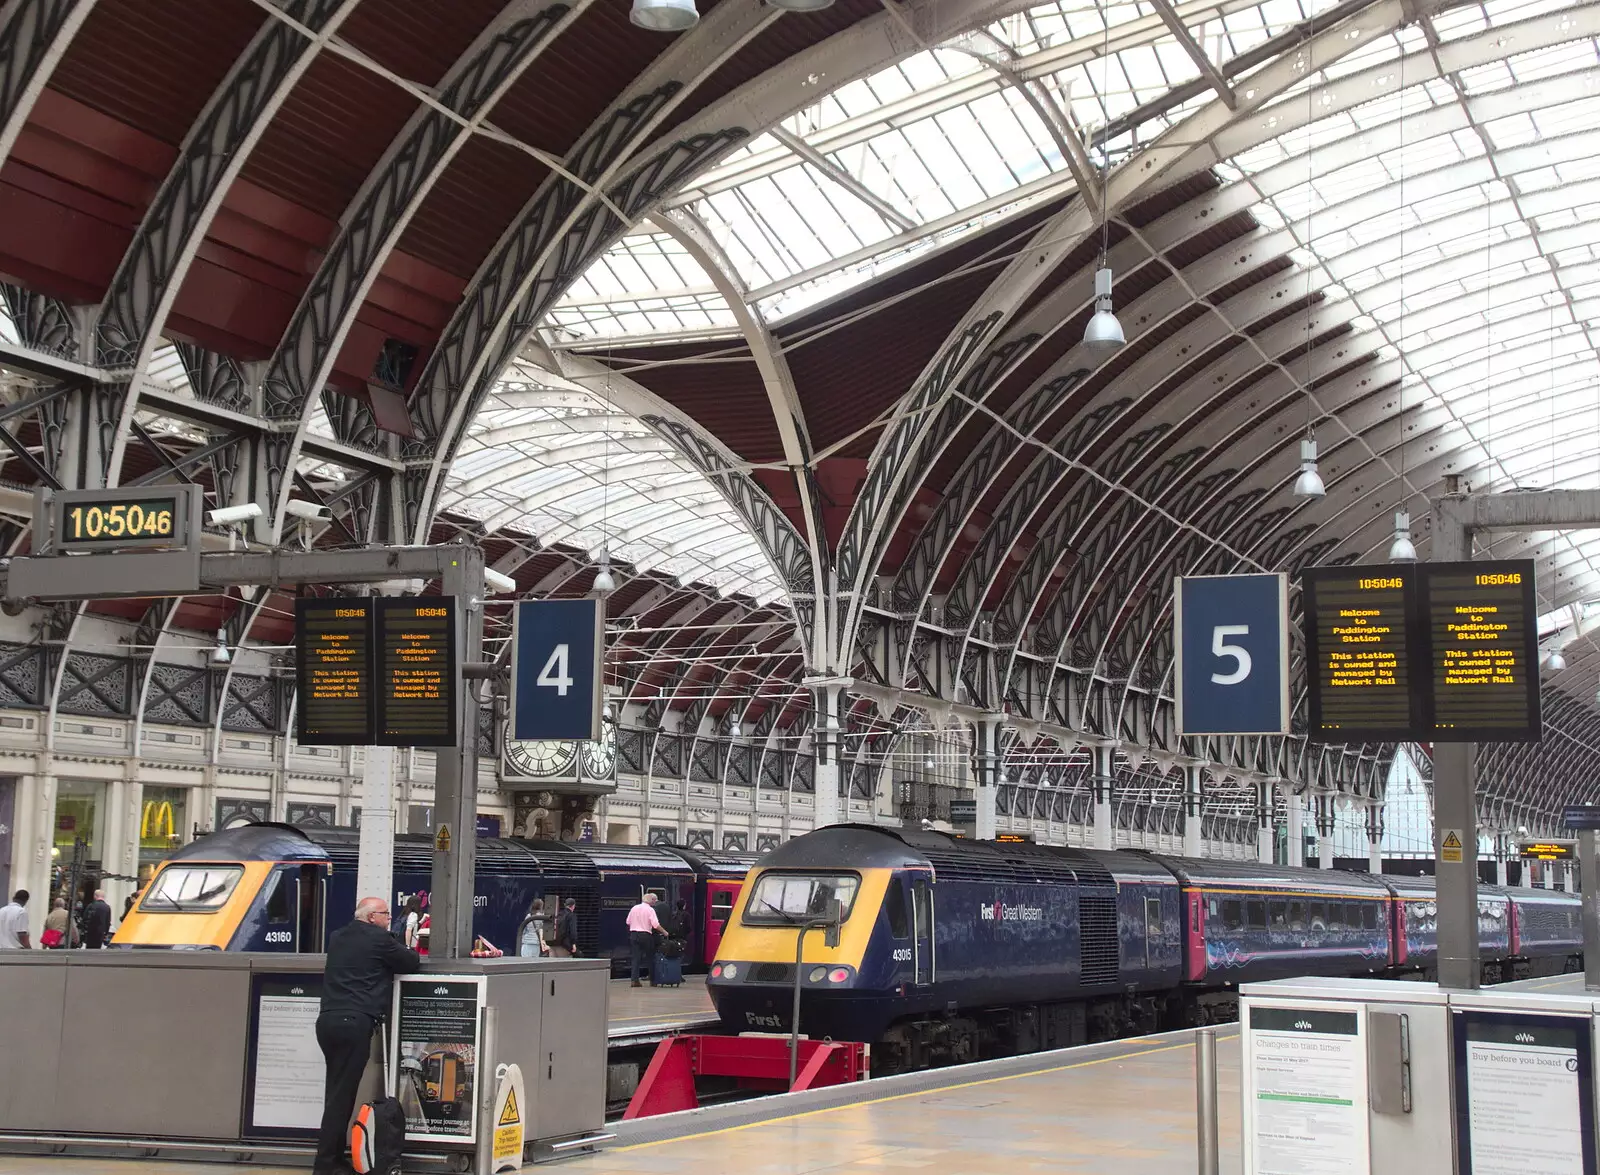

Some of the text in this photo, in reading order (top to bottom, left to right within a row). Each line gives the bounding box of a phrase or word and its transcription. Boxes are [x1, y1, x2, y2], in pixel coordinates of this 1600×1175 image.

[1359, 578, 1402, 589] 10:50:46
[1475, 574, 1521, 585] 10:50:46
[1211, 625, 1252, 684] 5
[537, 644, 573, 695] 4
[981, 903, 1042, 920] First Great Western
[265, 932, 291, 942] 43160
[893, 949, 911, 961] 43015
[746, 1012, 782, 1027] First
[1295, 1021, 1312, 1029] GWR
[1515, 1032, 1534, 1042] GWR
[1256, 1040, 1289, 1050] Changes
[1320, 1044, 1340, 1052] times
[1472, 1053, 1561, 1067] Buy before you board
